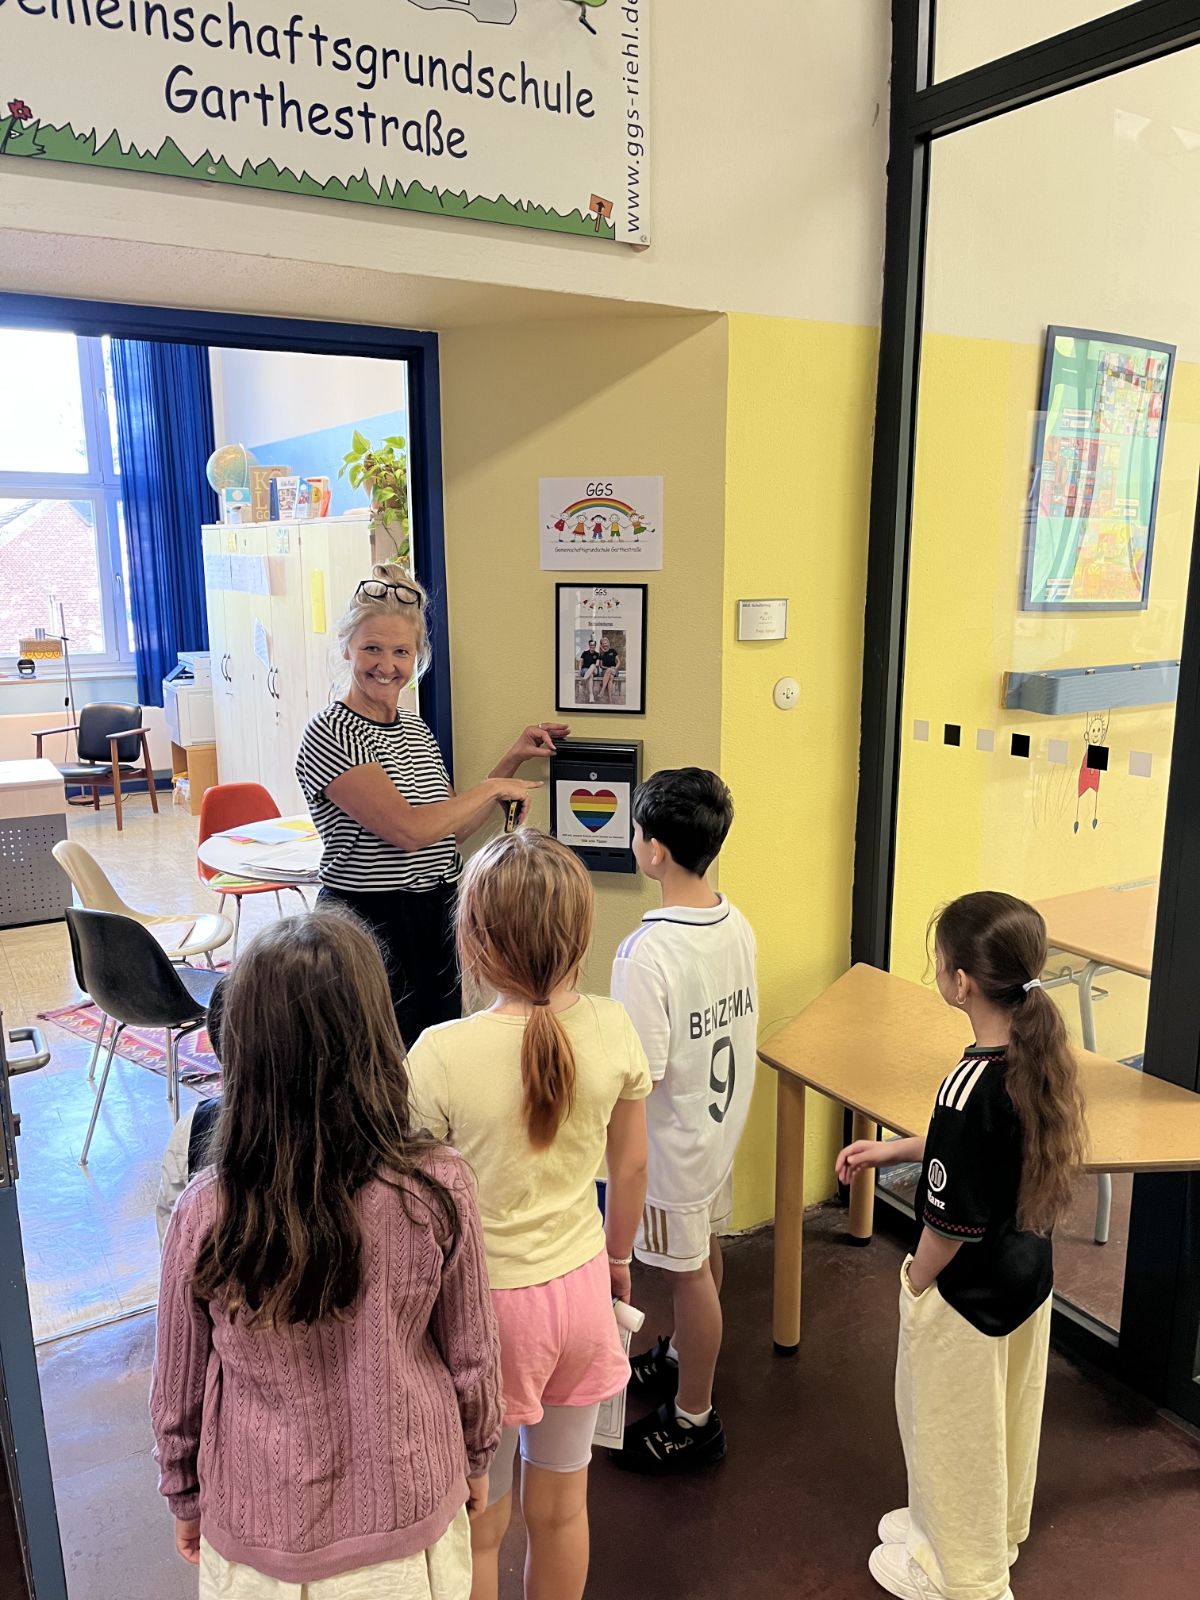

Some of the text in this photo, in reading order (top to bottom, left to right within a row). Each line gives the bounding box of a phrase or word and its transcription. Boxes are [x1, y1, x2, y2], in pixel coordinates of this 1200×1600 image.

[0, 0, 597, 118] meinschaftsgrundschule
[164, 64, 468, 159] Garthestraße
[586, 482, 614, 497] GGS
[708, 1035, 736, 1123] 9
[664, 1436, 694, 1454] FILA
